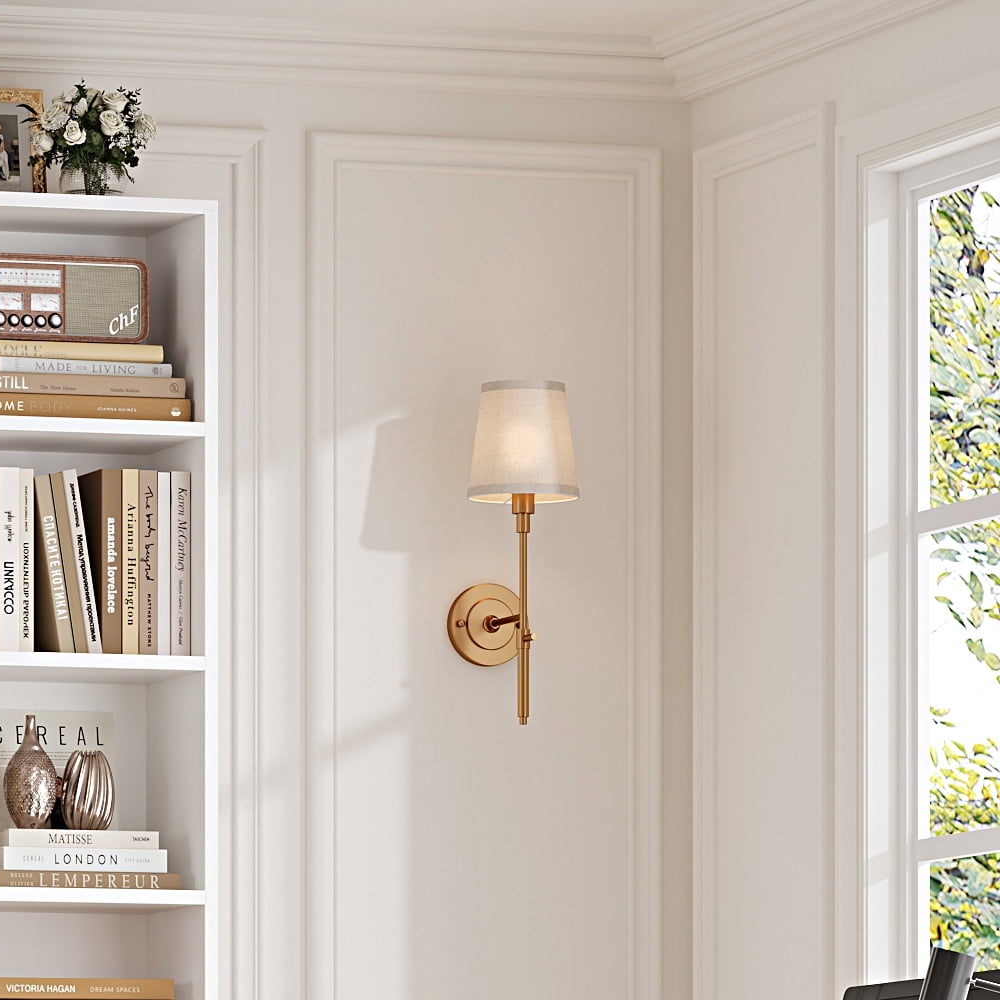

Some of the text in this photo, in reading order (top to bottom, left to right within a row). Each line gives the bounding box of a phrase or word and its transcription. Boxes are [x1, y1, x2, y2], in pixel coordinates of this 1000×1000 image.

[108, 304, 139, 335] ChF
[35, 362, 72, 372] MADE
[92, 364, 136, 375] LIVING
[144, 486, 154, 509] The
[178, 487, 188, 516] Karen
[175, 519, 188, 572] McCartney
[43, 515, 68, 620] СПАСИТЕ КОТИКА!
[107, 517, 118, 614] amanda lovelace
[125, 503, 137, 626] Arianna Huffington
[48, 833, 93, 845] MATISSE
[54, 853, 118, 865] LONDON
[39, 872, 161, 889] LEMPEREUR
[6, 984, 76, 993] VICTORIA HAGAN
[116, 986, 141, 994] SPACES
